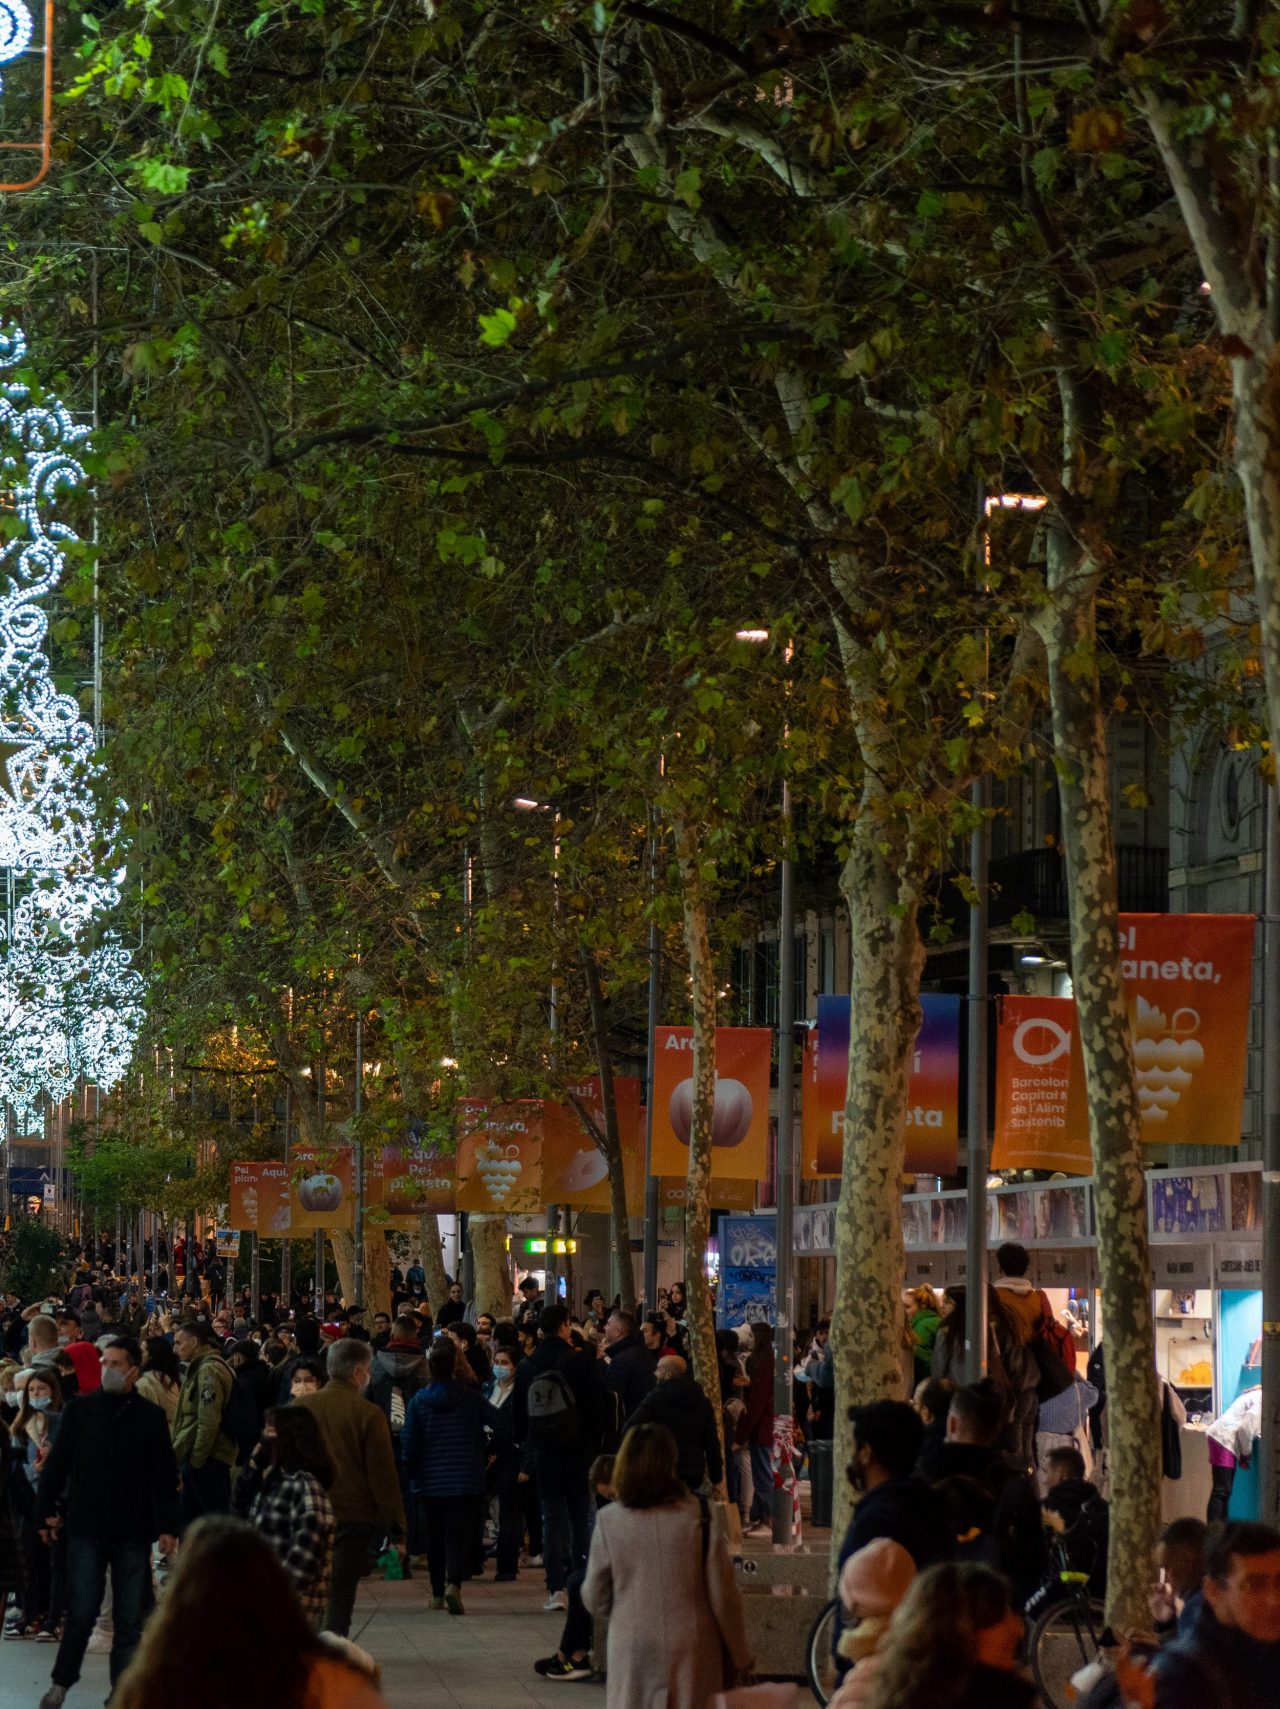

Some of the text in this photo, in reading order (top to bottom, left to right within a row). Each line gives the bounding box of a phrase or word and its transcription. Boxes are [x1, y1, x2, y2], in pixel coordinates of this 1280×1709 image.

[1121, 956, 1222, 984] aneta,
[1011, 1077, 1069, 1088] Barcelon
[1011, 1090, 1058, 1101] Capital
[1011, 1102, 1065, 1114] de l'Alim
[1011, 1116, 1066, 1128] Sostenib
[234, 1174, 258, 1185] plan
